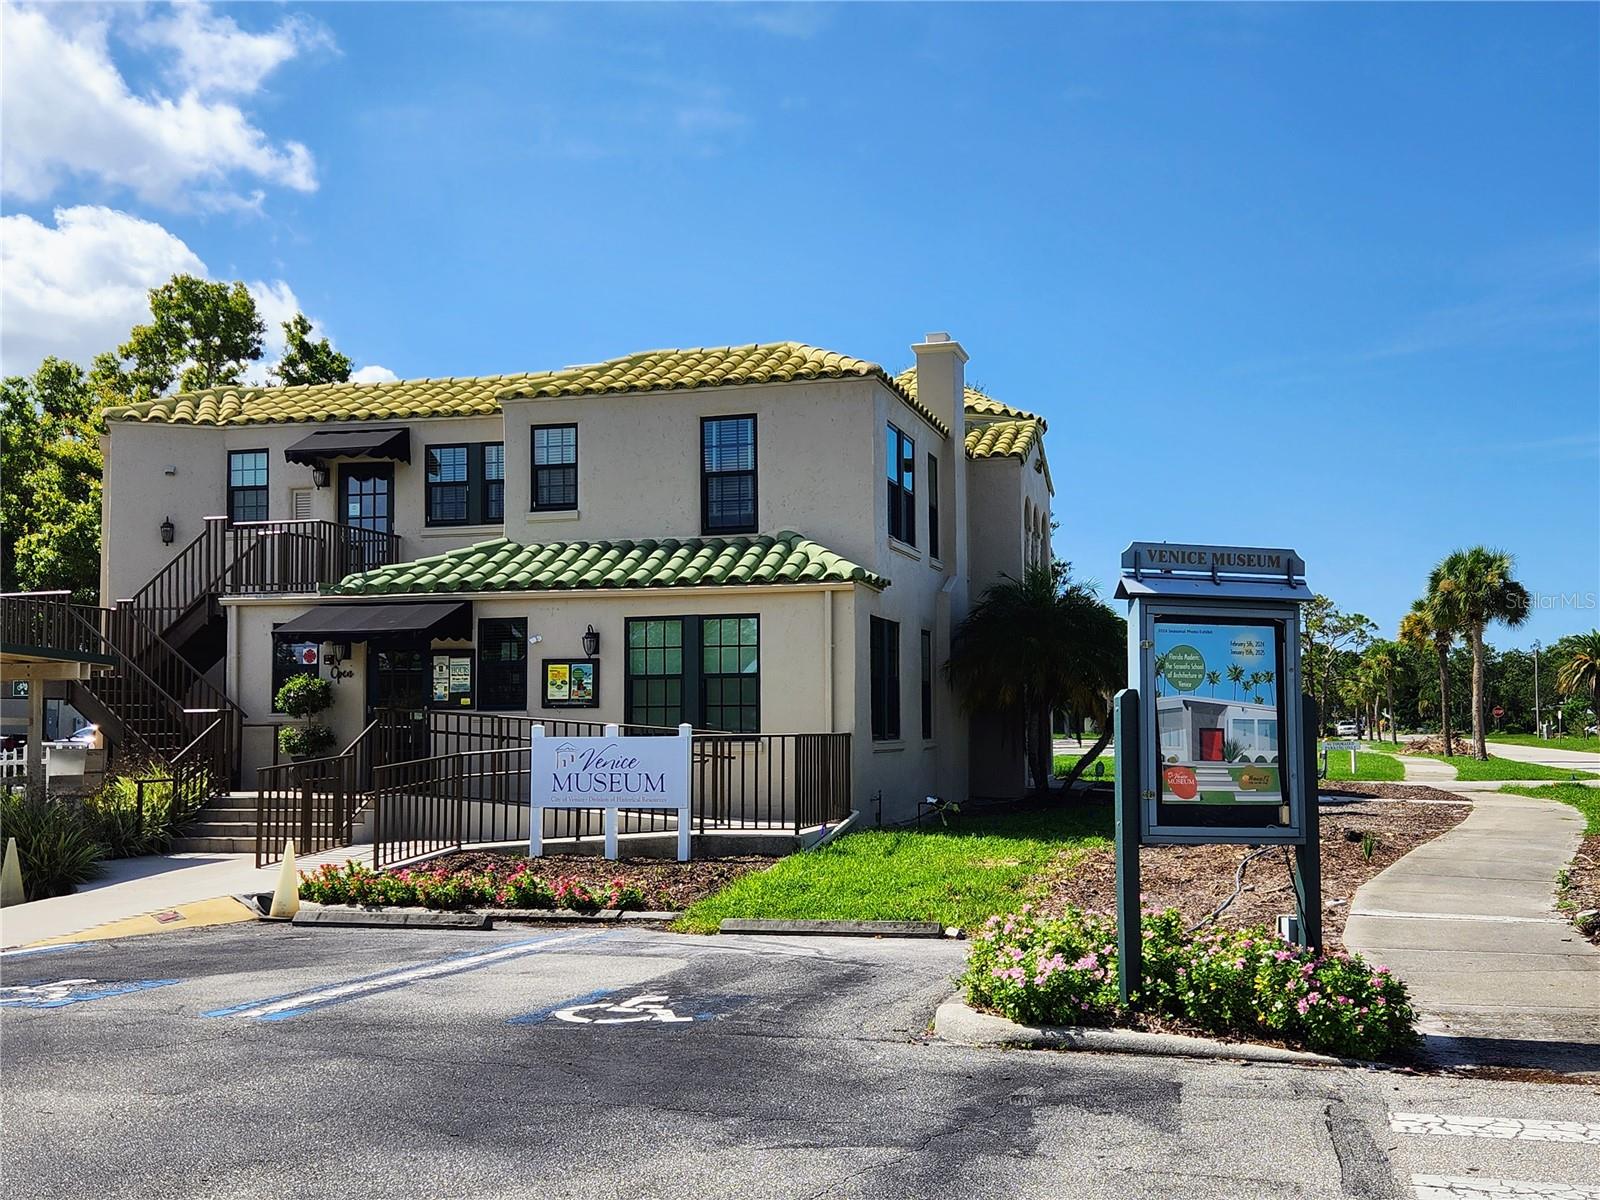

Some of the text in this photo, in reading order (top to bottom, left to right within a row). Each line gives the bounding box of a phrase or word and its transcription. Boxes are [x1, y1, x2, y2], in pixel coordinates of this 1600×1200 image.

[1147, 549, 1281, 569] VENICE MUSEUM
[1230, 640, 1246, 648] February
[330, 665, 355, 685] Open
[1173, 671, 1197, 679] Architecture
[1191, 662, 1204, 670] School
[579, 744, 641, 772] Venice
[552, 773, 666, 793] MUSEUM
